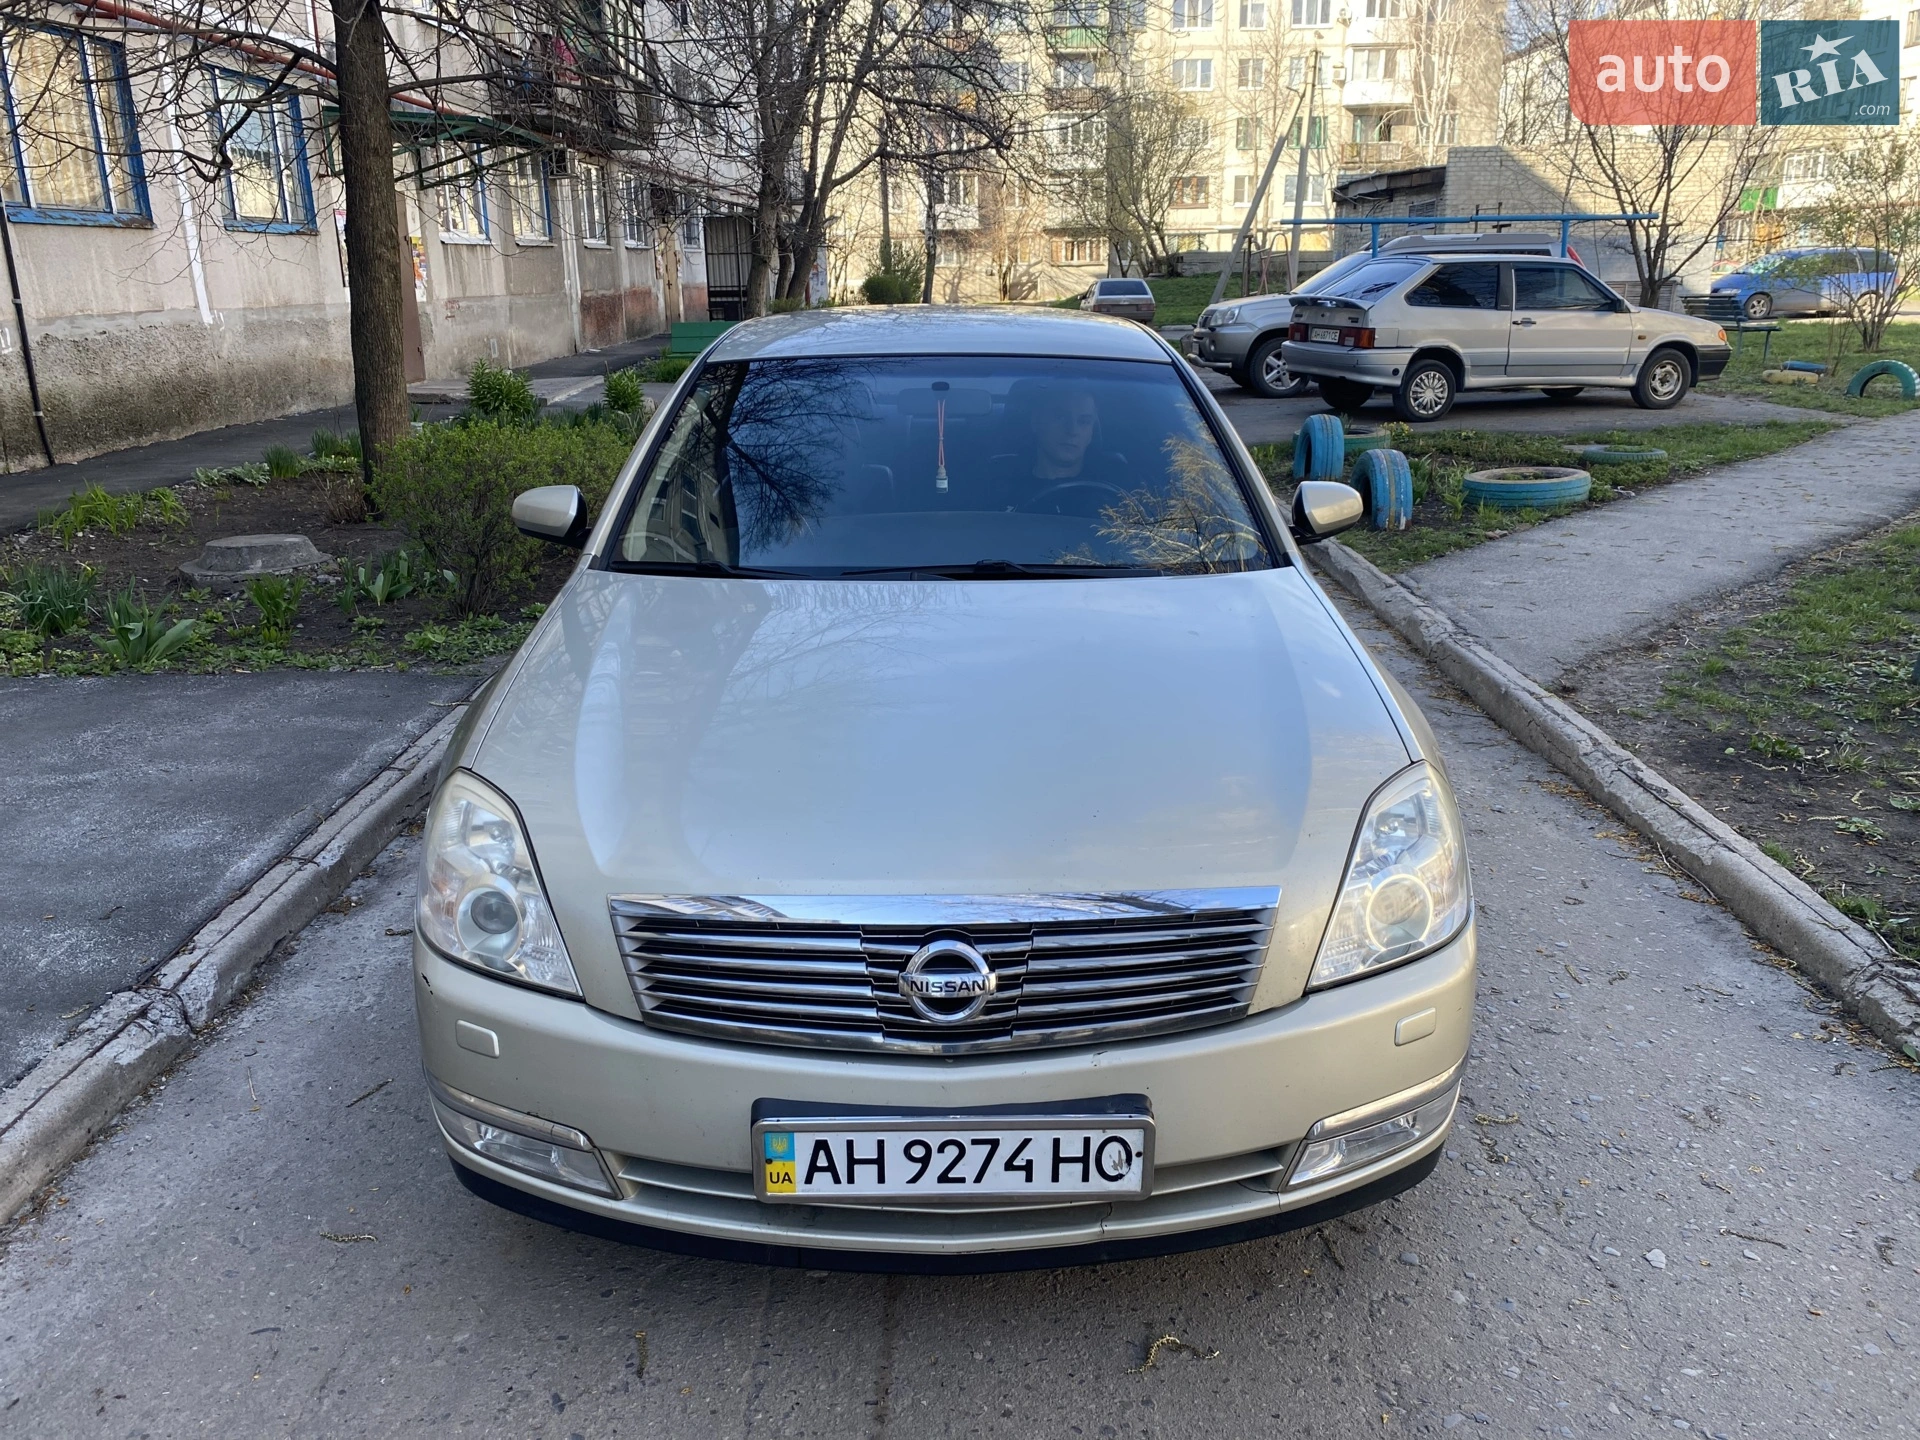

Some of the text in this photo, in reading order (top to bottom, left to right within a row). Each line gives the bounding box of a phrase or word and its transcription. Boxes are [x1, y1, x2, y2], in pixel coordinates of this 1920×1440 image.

[910, 980, 986, 993] NISSAN
[803, 1138, 886, 1185] AH
[903, 1137, 1034, 1185] 9274
[769, 1171, 793, 1185] UA
